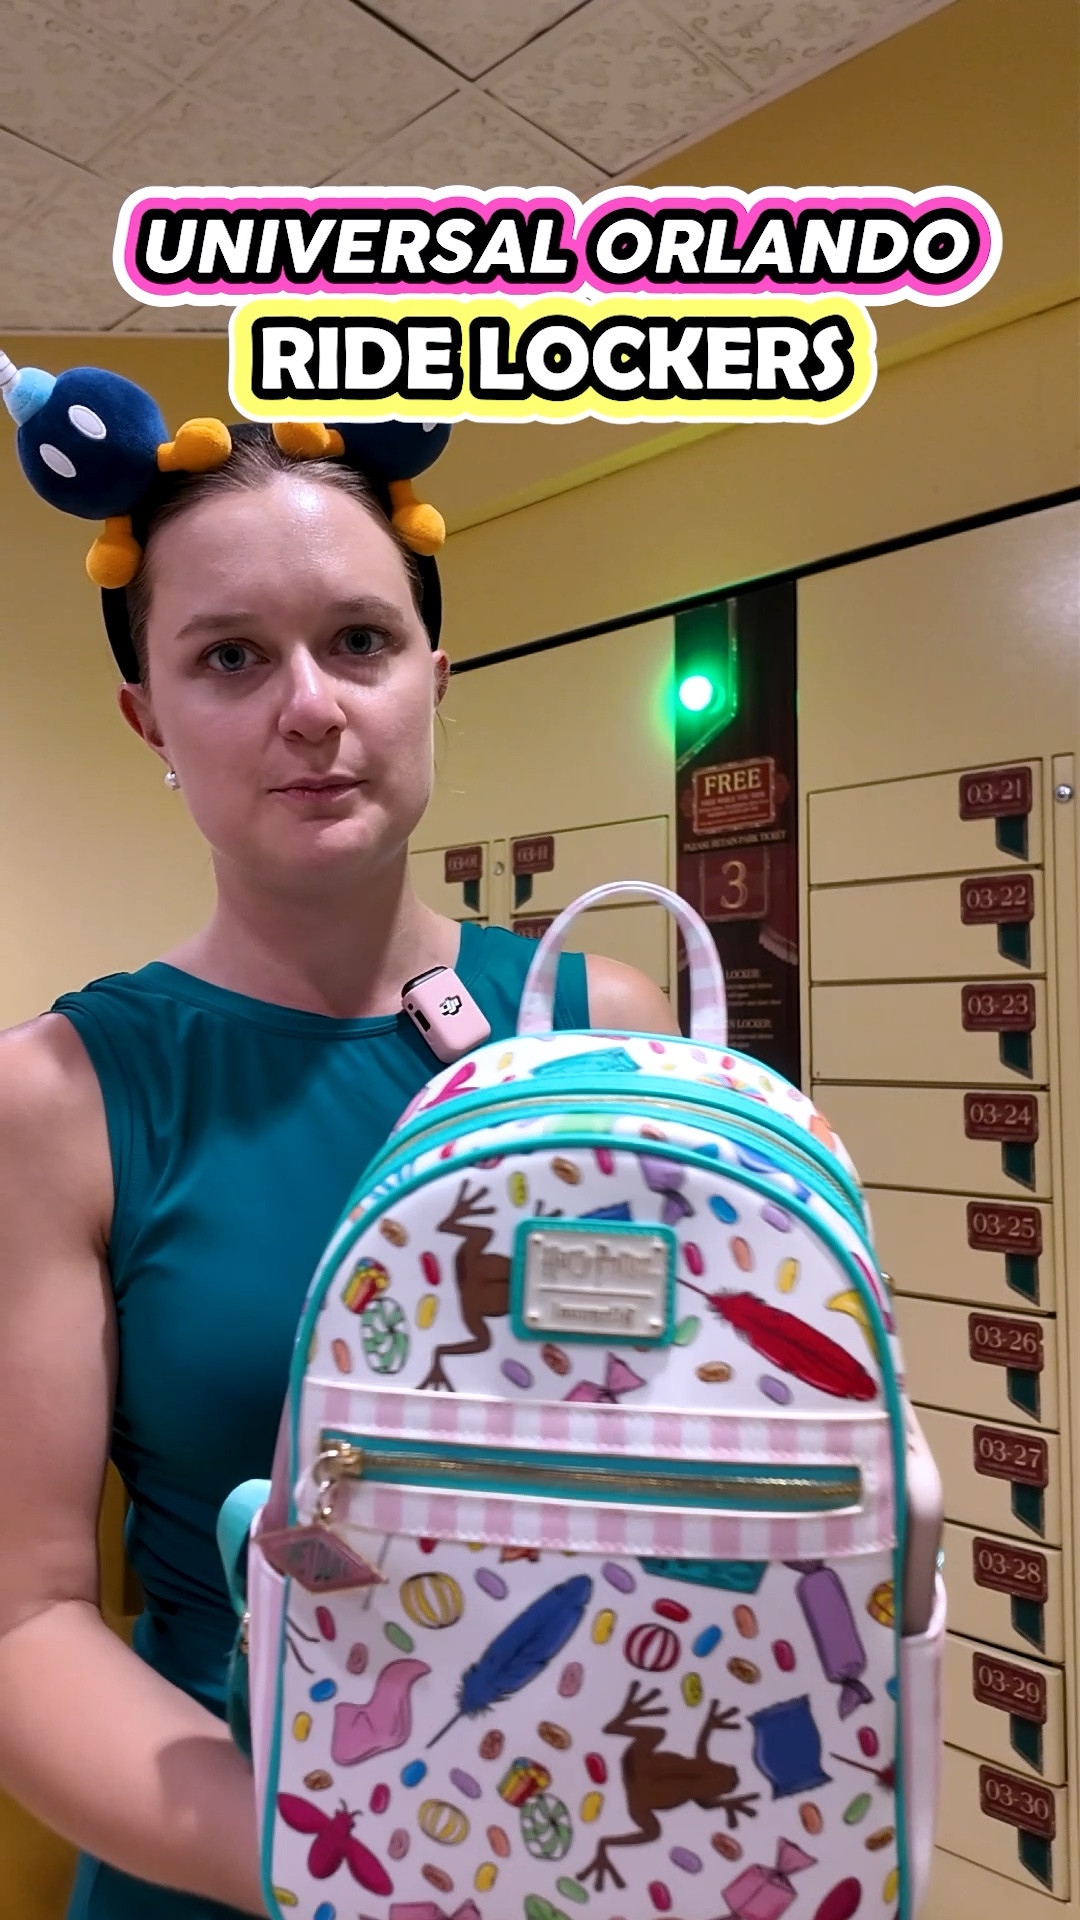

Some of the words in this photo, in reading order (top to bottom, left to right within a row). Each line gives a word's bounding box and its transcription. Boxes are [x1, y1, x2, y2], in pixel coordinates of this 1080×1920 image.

[705, 767, 762, 797] FREE
[967, 778, 1022, 804] 03-21
[720, 861, 748, 909] 3
[966, 885, 1026, 909] 03-22
[967, 994, 1028, 1016] 03-23
[970, 1102, 1031, 1126] 03-24
[973, 1212, 1035, 1239] 03-25
[974, 1324, 1037, 1354] 03-26
[979, 1437, 1041, 1468] 03-27
[978, 1550, 1041, 1584] 03-28
[979, 1665, 1040, 1704] 03-29
[985, 1778, 1049, 1820] 03-30
